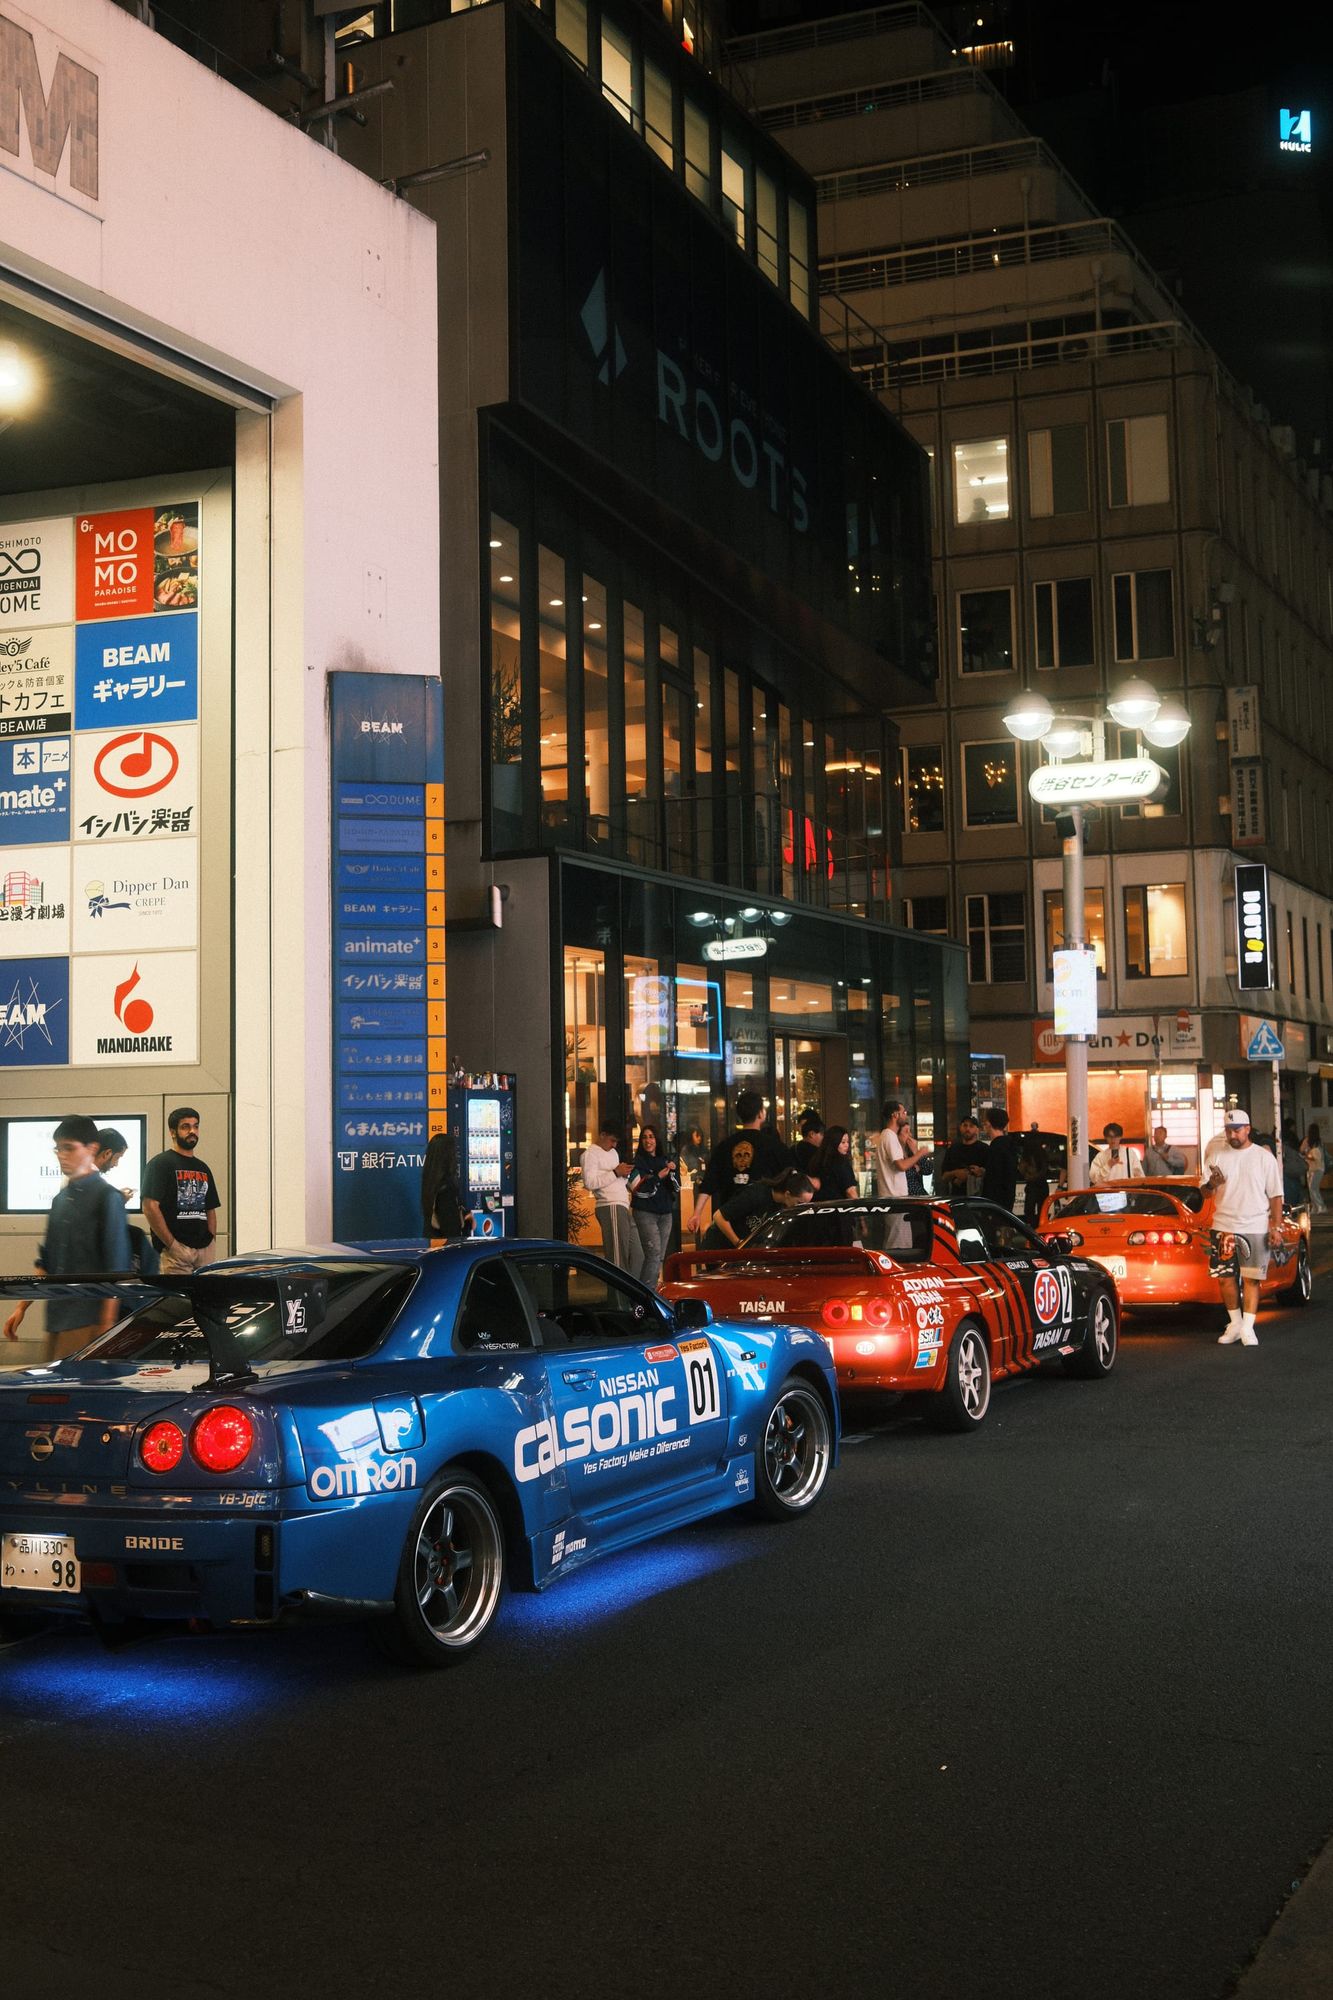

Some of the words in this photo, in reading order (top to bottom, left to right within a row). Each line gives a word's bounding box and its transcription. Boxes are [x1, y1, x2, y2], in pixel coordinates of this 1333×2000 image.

[1280, 141, 1311, 153] HULIC
[657, 350, 808, 533] ROOTS
[80, 520, 94, 532] 6F
[95, 529, 137, 555] MO
[95, 562, 137, 587] MO
[95, 586, 137, 597] PARADISE
[103, 642, 170, 668] BEAM
[25, 657, 50, 670] Café
[93, 675, 186, 703] ギャラリー
[0, 718, 47, 733] BEAM店
[361, 721, 403, 734] BEAM
[17, 748, 35, 769] 本
[43, 751, 68, 764] アニメ
[79, 806, 194, 838] イシバシ楽器
[431, 833, 438, 841] 6
[431, 868, 438, 876] 5
[113, 879, 158, 897] Dipper
[162, 877, 189, 891] Dan
[135, 897, 166, 907] CREPE
[343, 904, 377, 913] BEAM
[431, 904, 438, 912] 4
[1242, 890, 1265, 964] DOUTOR
[432, 941, 439, 949] 3
[343, 974, 423, 990] イシバシ楽器
[97, 1036, 173, 1053] MANDARAKE
[356, 1122, 423, 1137] まんだらけ
[797, 1206, 891, 1216] ADVAN
[903, 1276, 945, 1292] ADVAN
[907, 1290, 944, 1306] TAISAN
[1038, 1277, 1057, 1313] STP
[739, 1301, 785, 1313] TAISAN
[680, 1344, 689, 1353] Yes
[689, 1340, 708, 1350] Factory
[1033, 1328, 1062, 1350] TAISAN
[600, 1368, 659, 1398] NISSAN
[690, 1358, 715, 1415] 01
[584, 1463, 597, 1475] Yes
[599, 1454, 628, 1471] Factory
[629, 1448, 649, 1462] Make
[650, 1448, 655, 1456] a
[125, 1536, 184, 1551] BRIDE
[5, 1564, 15, 1576] わ
[52, 1560, 75, 1588] 98
